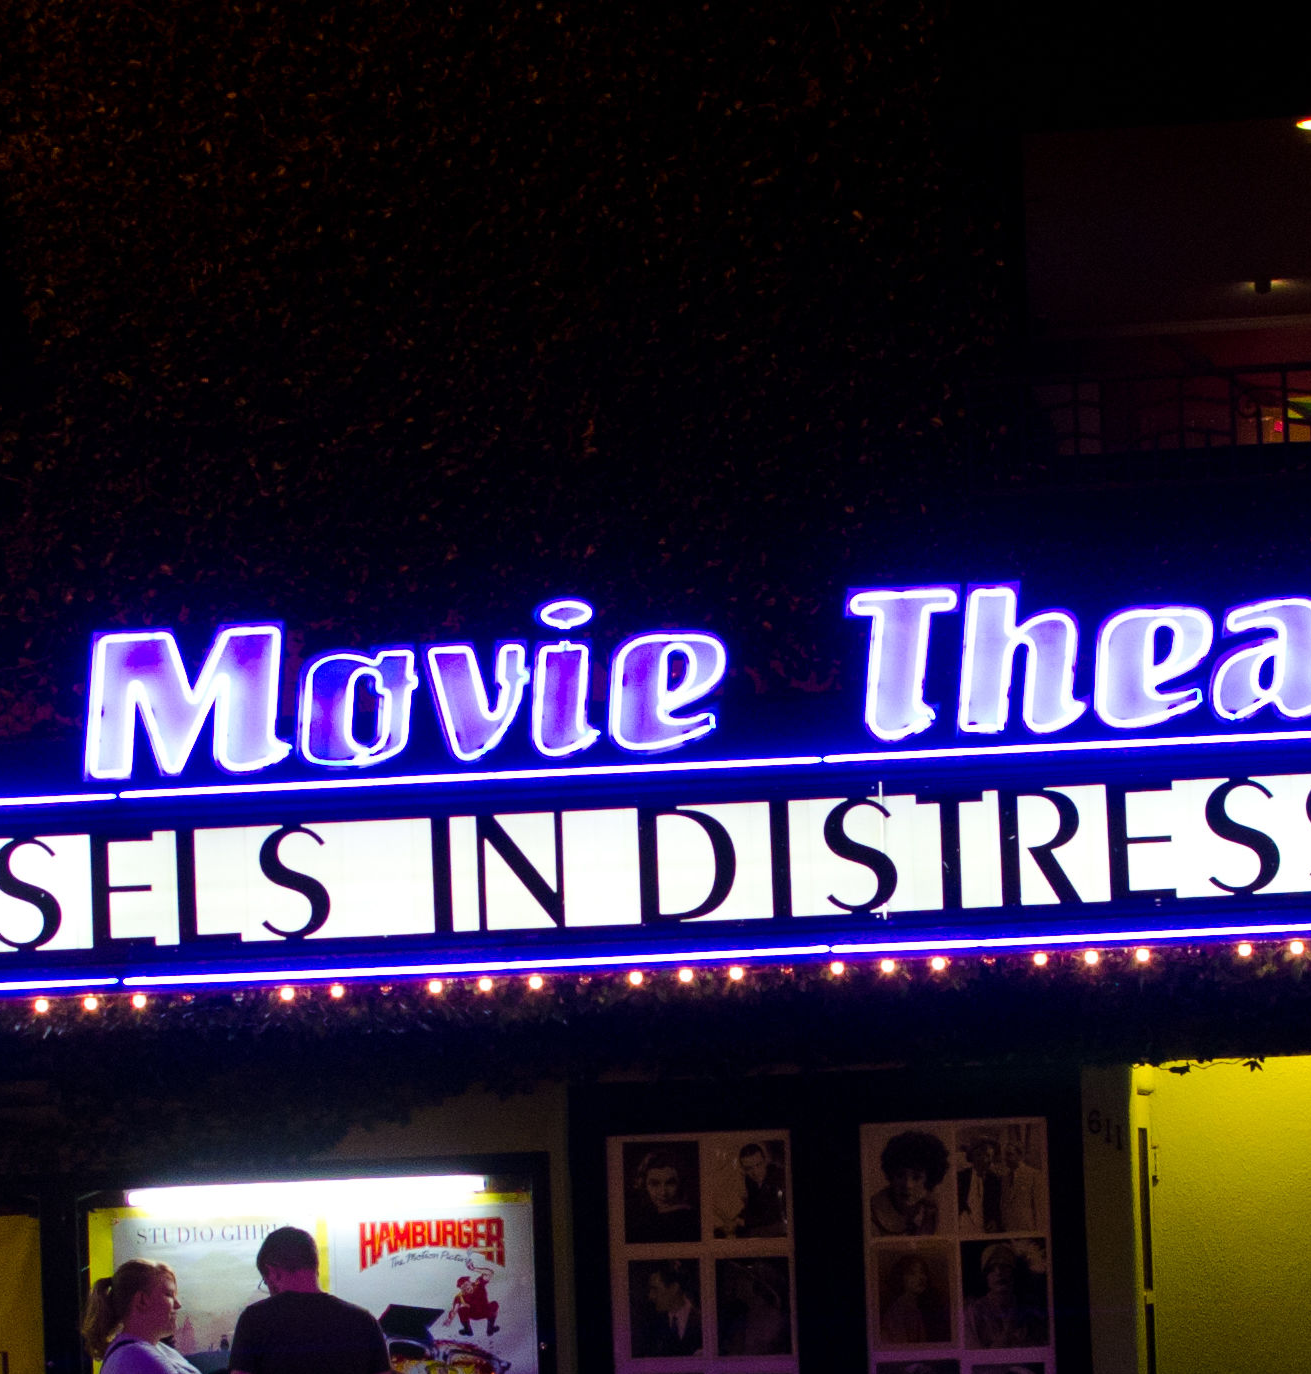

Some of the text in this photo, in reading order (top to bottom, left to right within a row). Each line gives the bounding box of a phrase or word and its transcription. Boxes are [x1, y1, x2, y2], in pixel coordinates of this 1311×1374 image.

[84, 598, 728, 782] Movie
[430, 811, 566, 934] IN
[137, 1226, 214, 1245] STUDIO
[358, 1216, 506, 1272] HAMBURGER
